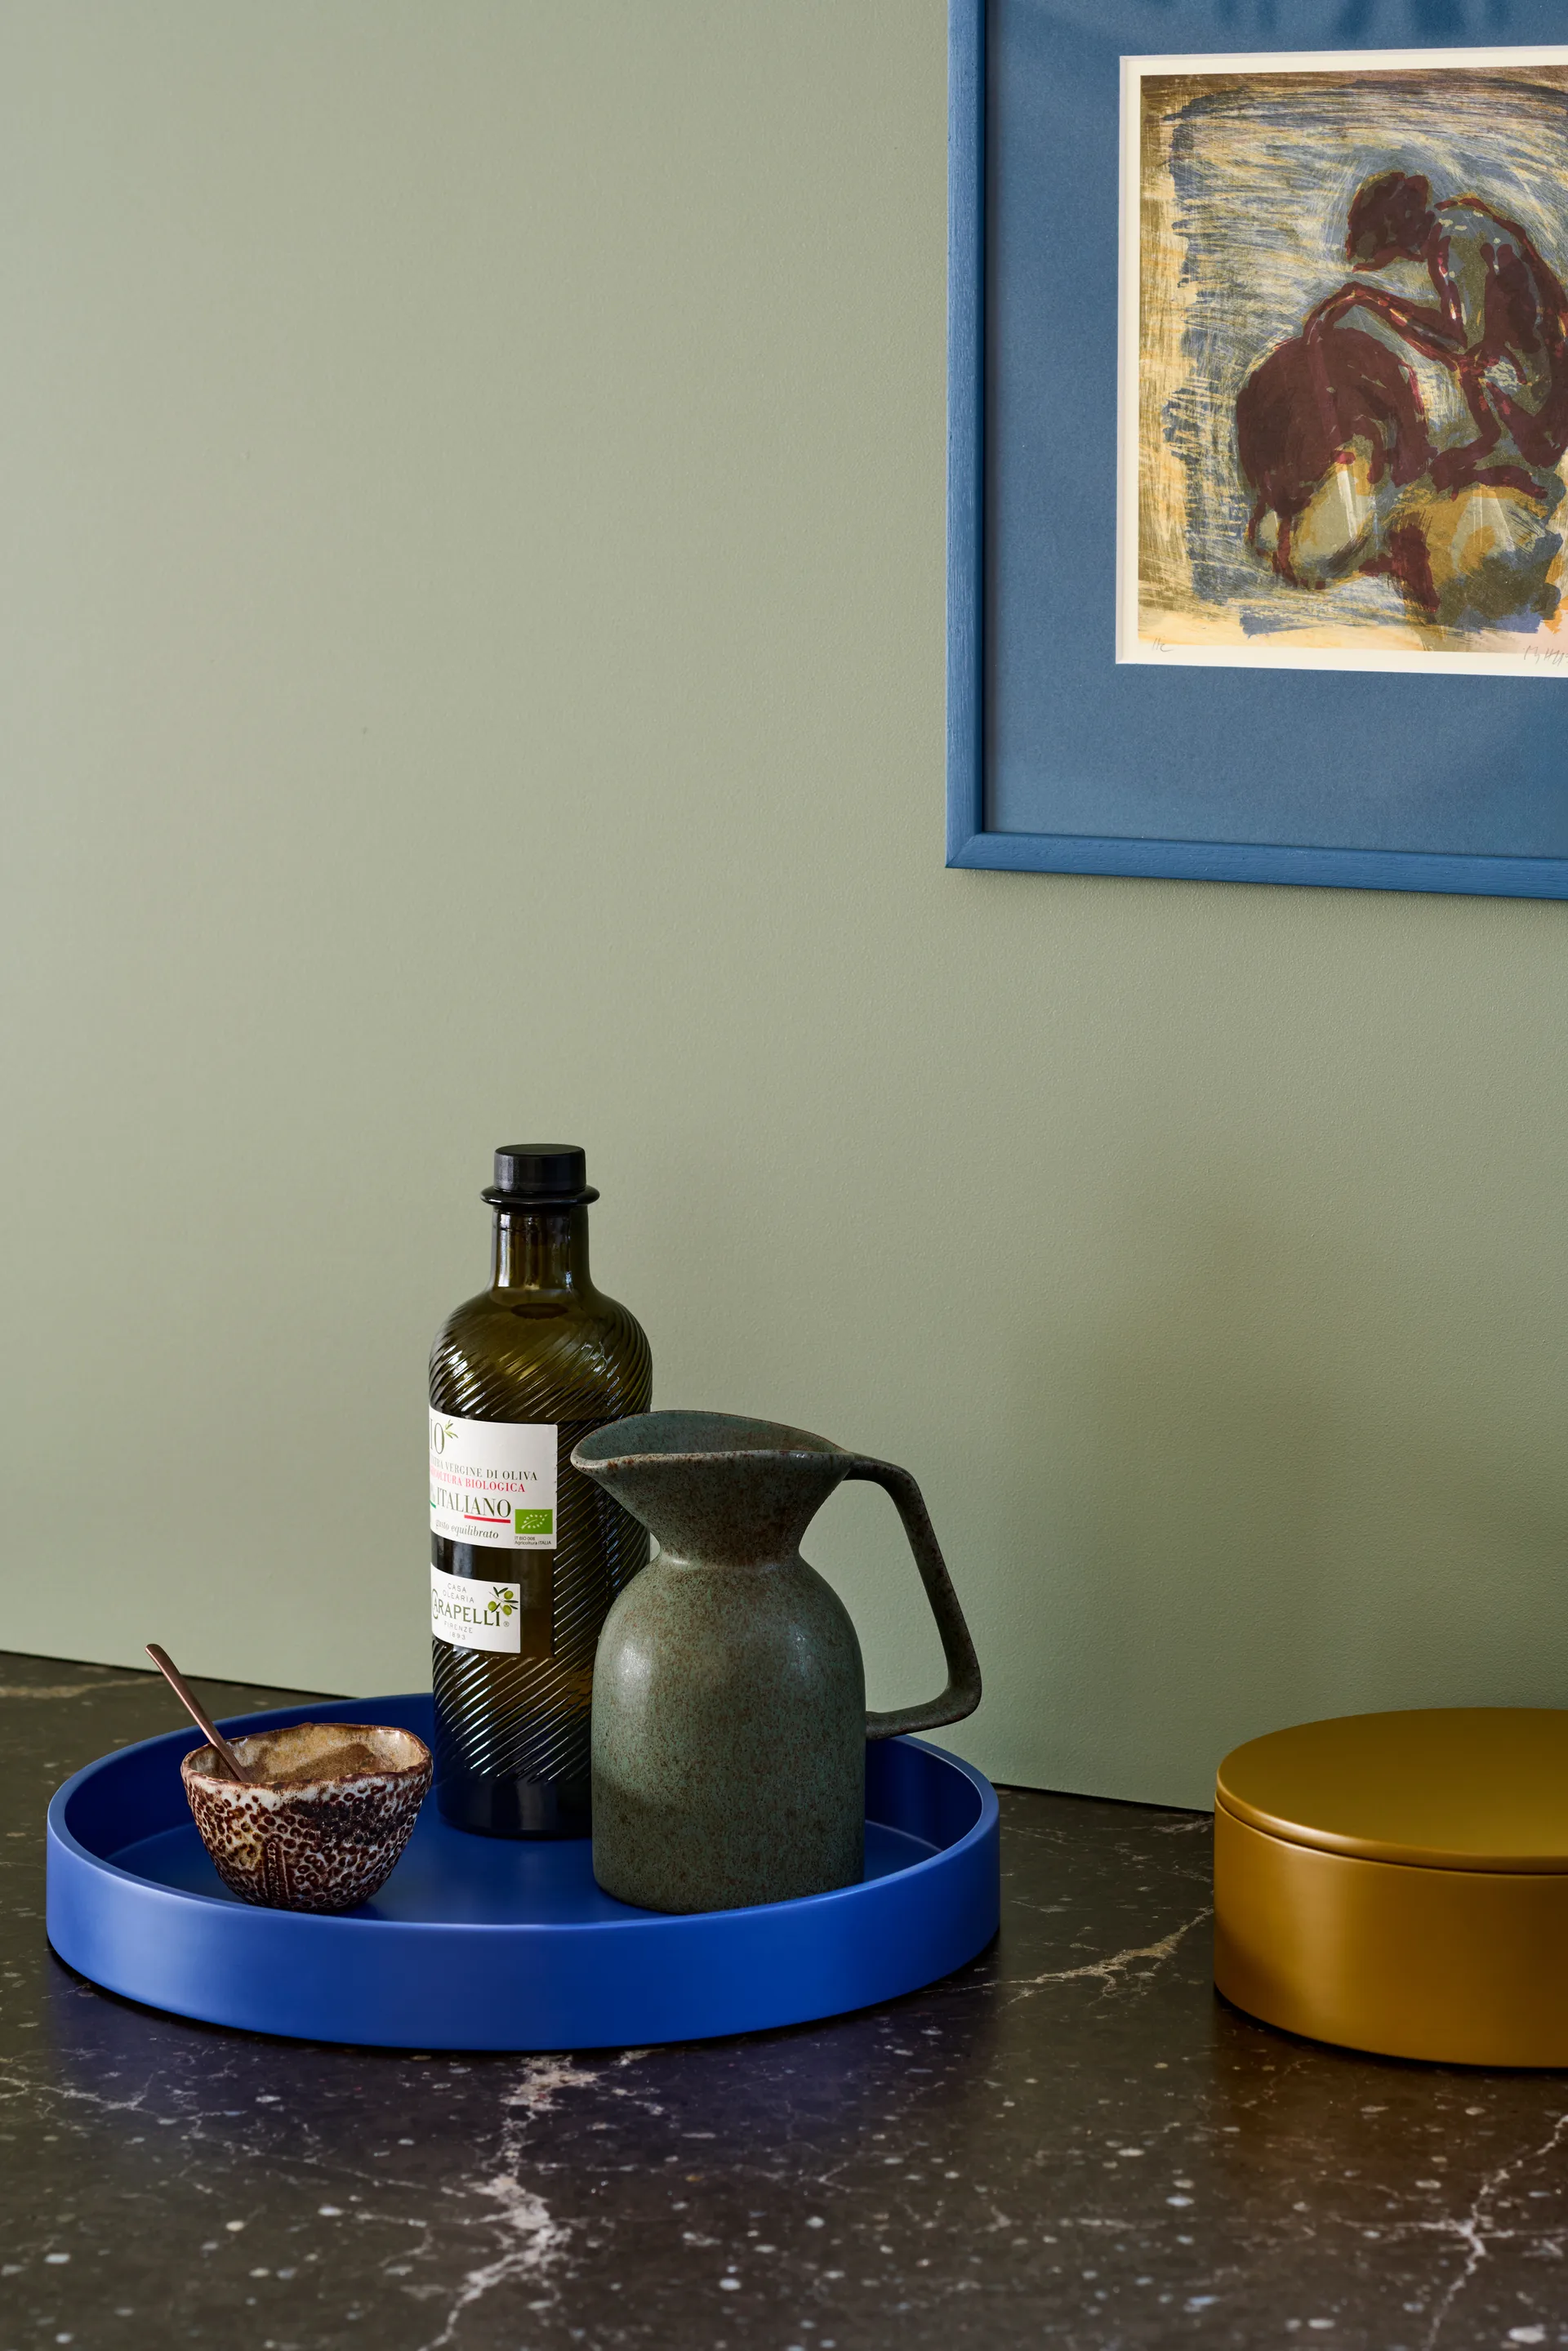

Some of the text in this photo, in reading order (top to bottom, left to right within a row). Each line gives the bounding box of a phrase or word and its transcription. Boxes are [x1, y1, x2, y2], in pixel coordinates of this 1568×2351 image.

[444, 1461, 483, 1478] VERGINE
[486, 1469, 497, 1479] DI
[502, 1470, 538, 1481] OLIVA
[466, 1478, 526, 1493] BIOLOGICA
[436, 1486, 511, 1518] ITALIANO
[451, 1525, 499, 1539] equilibrato
[448, 1583, 467, 1594] CASA
[443, 1589, 474, 1603] OLEARIA
[431, 1588, 501, 1627] CARAPELLI
[443, 1621, 474, 1634] FIRENZE
[449, 1632, 466, 1641] 1893
